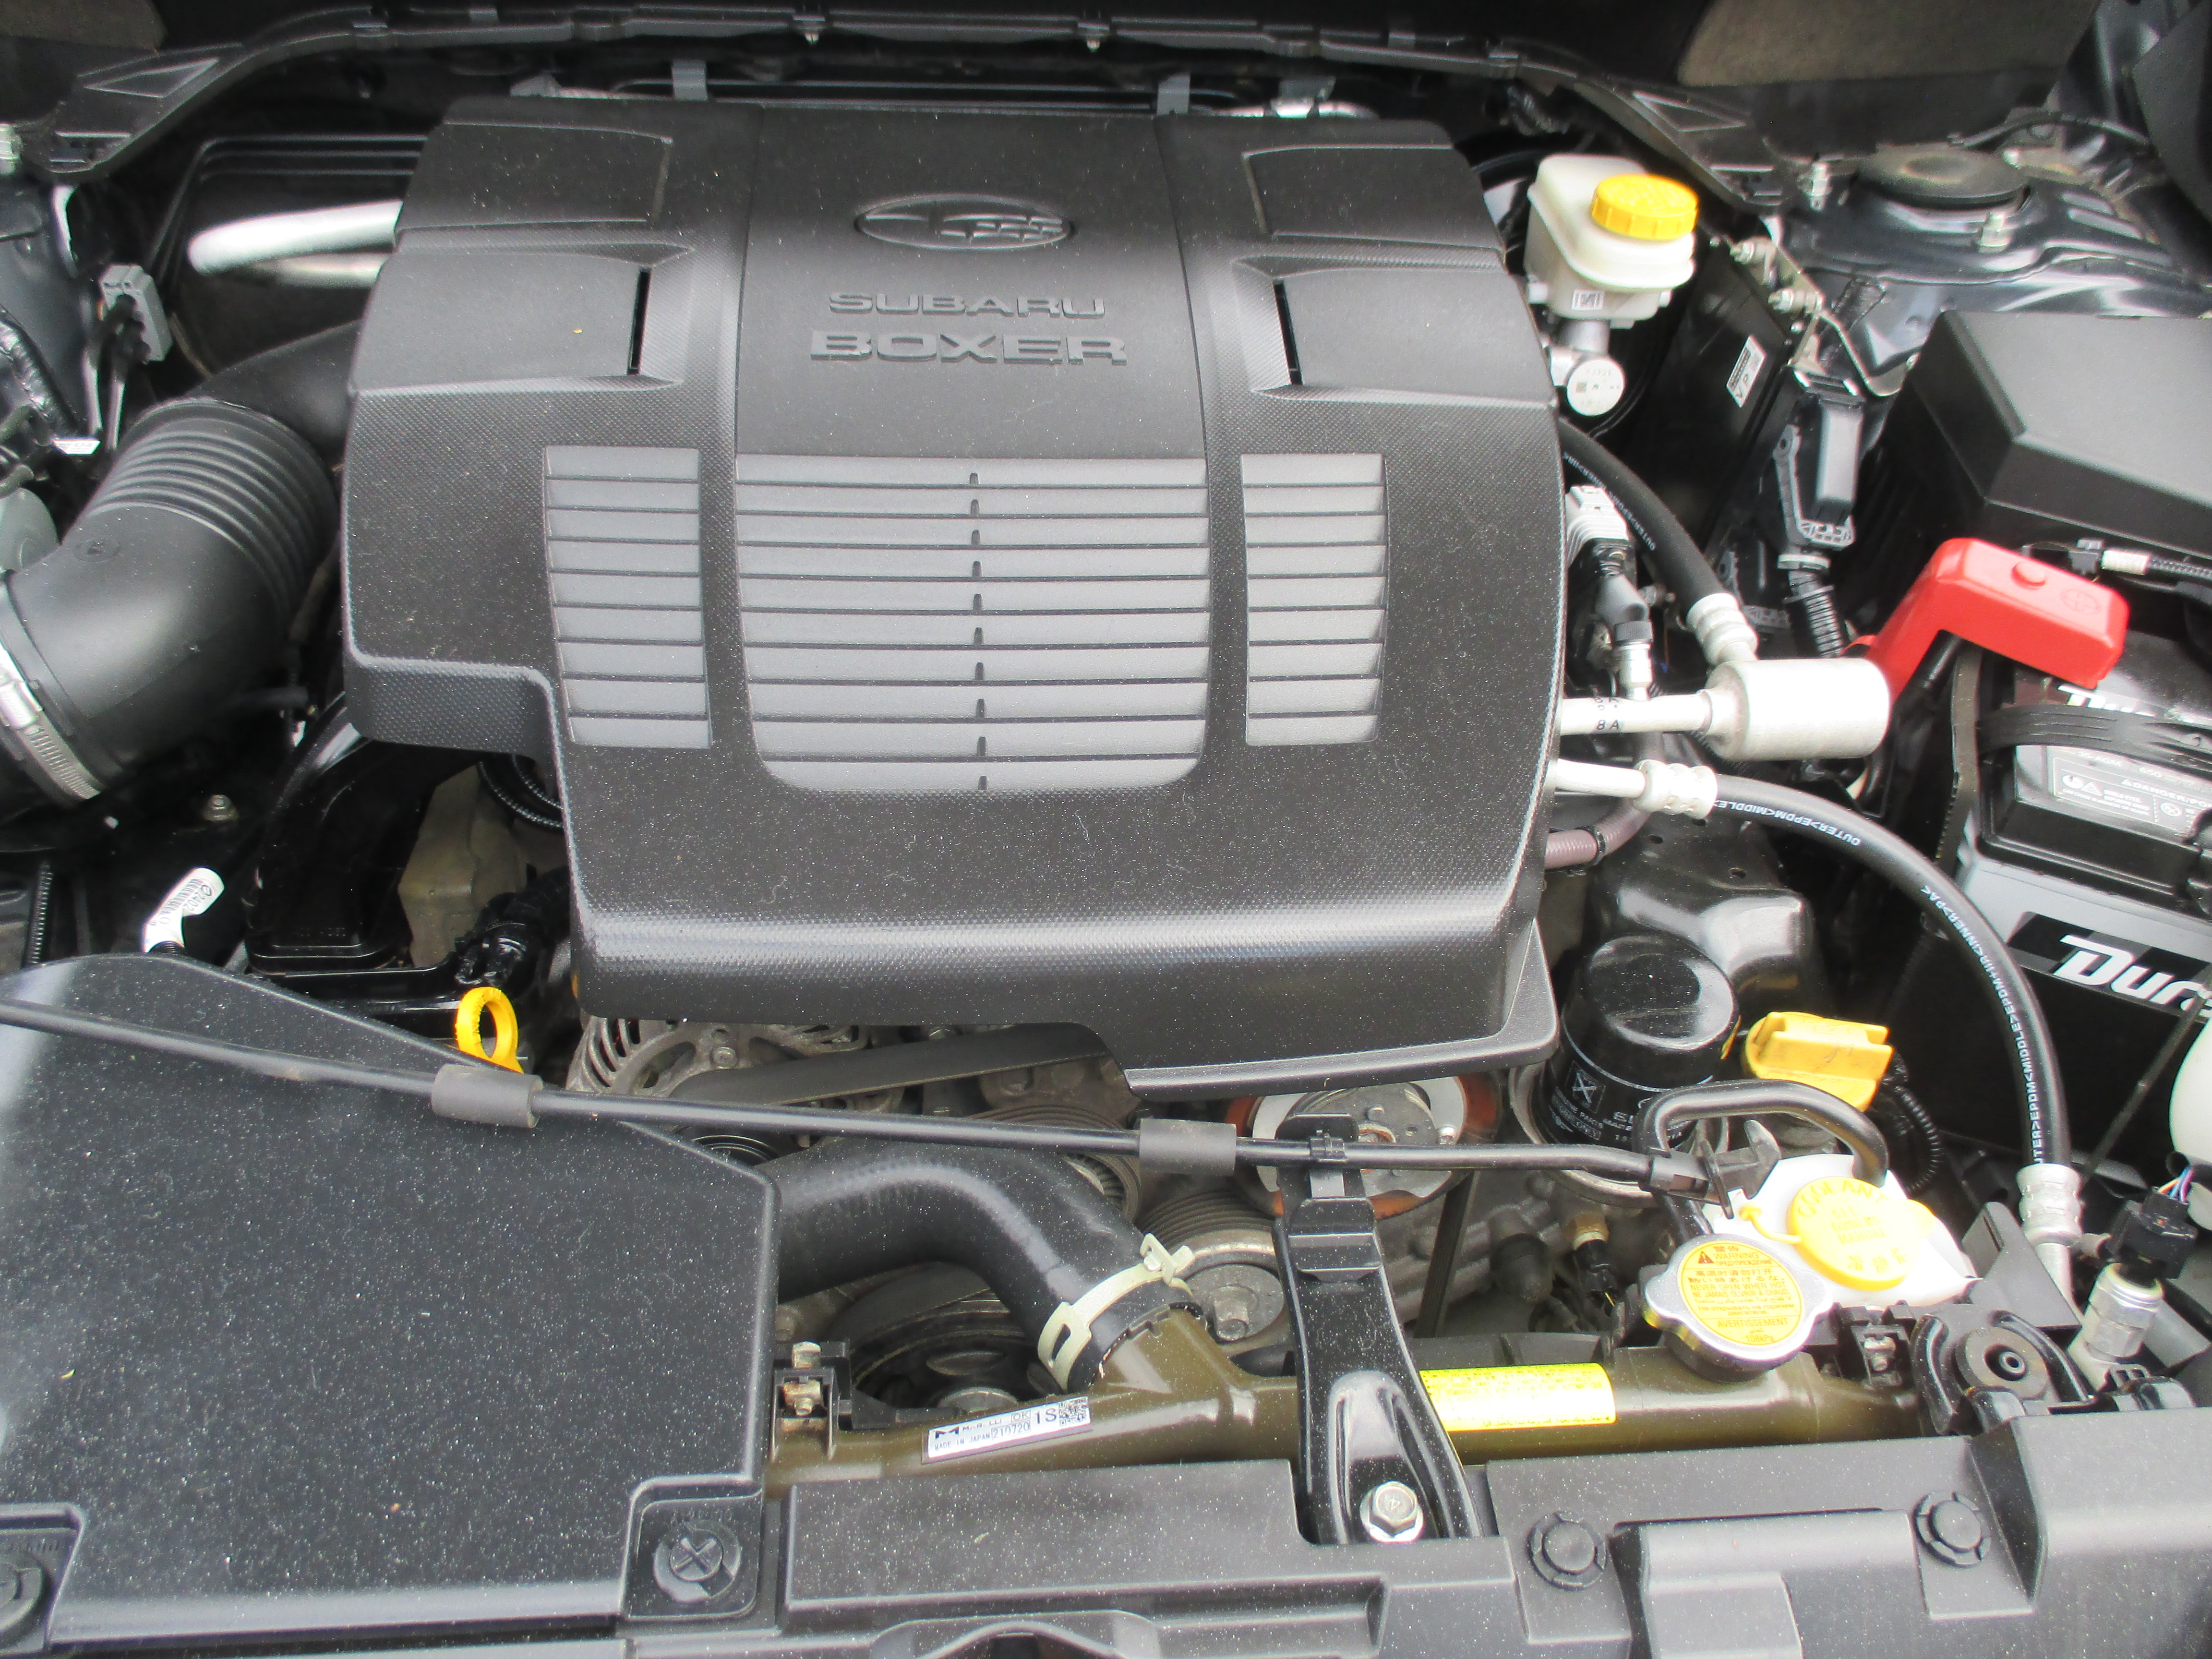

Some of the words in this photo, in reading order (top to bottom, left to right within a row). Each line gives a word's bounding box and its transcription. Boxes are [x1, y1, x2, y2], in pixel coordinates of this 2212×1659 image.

[829, 293, 1105, 318] SUBARU
[810, 330, 1127, 365] BOXER
[2133, 782, 2212, 807] DANGER/PO
[1797, 1180, 1888, 1217] COOLANT
[1704, 1290, 1729, 1298] JAMAIS
[1731, 1289, 1756, 1298] OUVRIR
[1717, 1317, 1789, 1328] AVERTISSEMENT
[1745, 1334, 1776, 1343] 108kPa
[1012, 1410, 1030, 1422] OK
[934, 1440, 951, 1451] MADE
[955, 1437, 965, 1445] IN
[968, 1431, 991, 1444] JAPAN
[992, 1421, 1030, 1438] 210720
